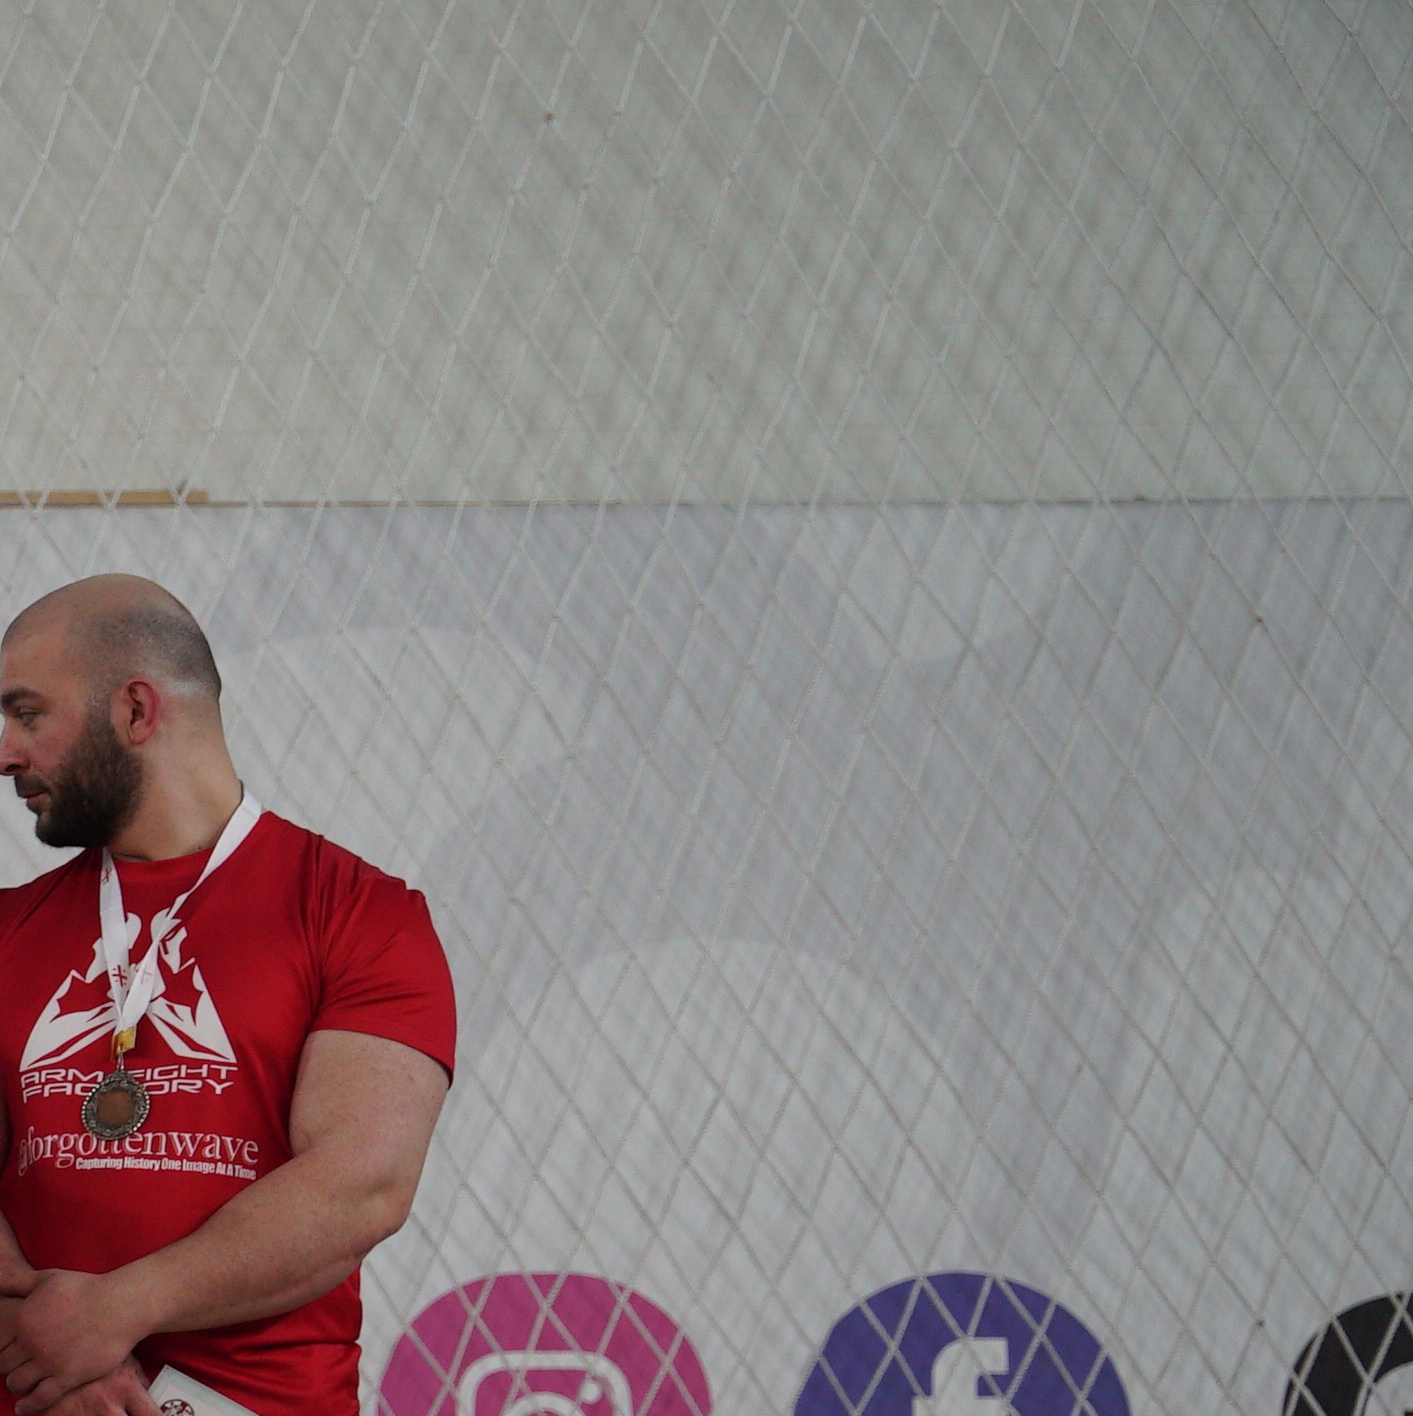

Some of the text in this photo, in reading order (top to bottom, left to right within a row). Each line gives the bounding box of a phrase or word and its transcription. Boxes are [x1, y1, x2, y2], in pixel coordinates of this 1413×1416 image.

[22, 1079, 235, 1104] FACORY
[75, 1156, 123, 1171] Capturing
[124, 1156, 161, 1171] History
[161, 1157, 182, 1171] One
[182, 1158, 215, 1175] Image
